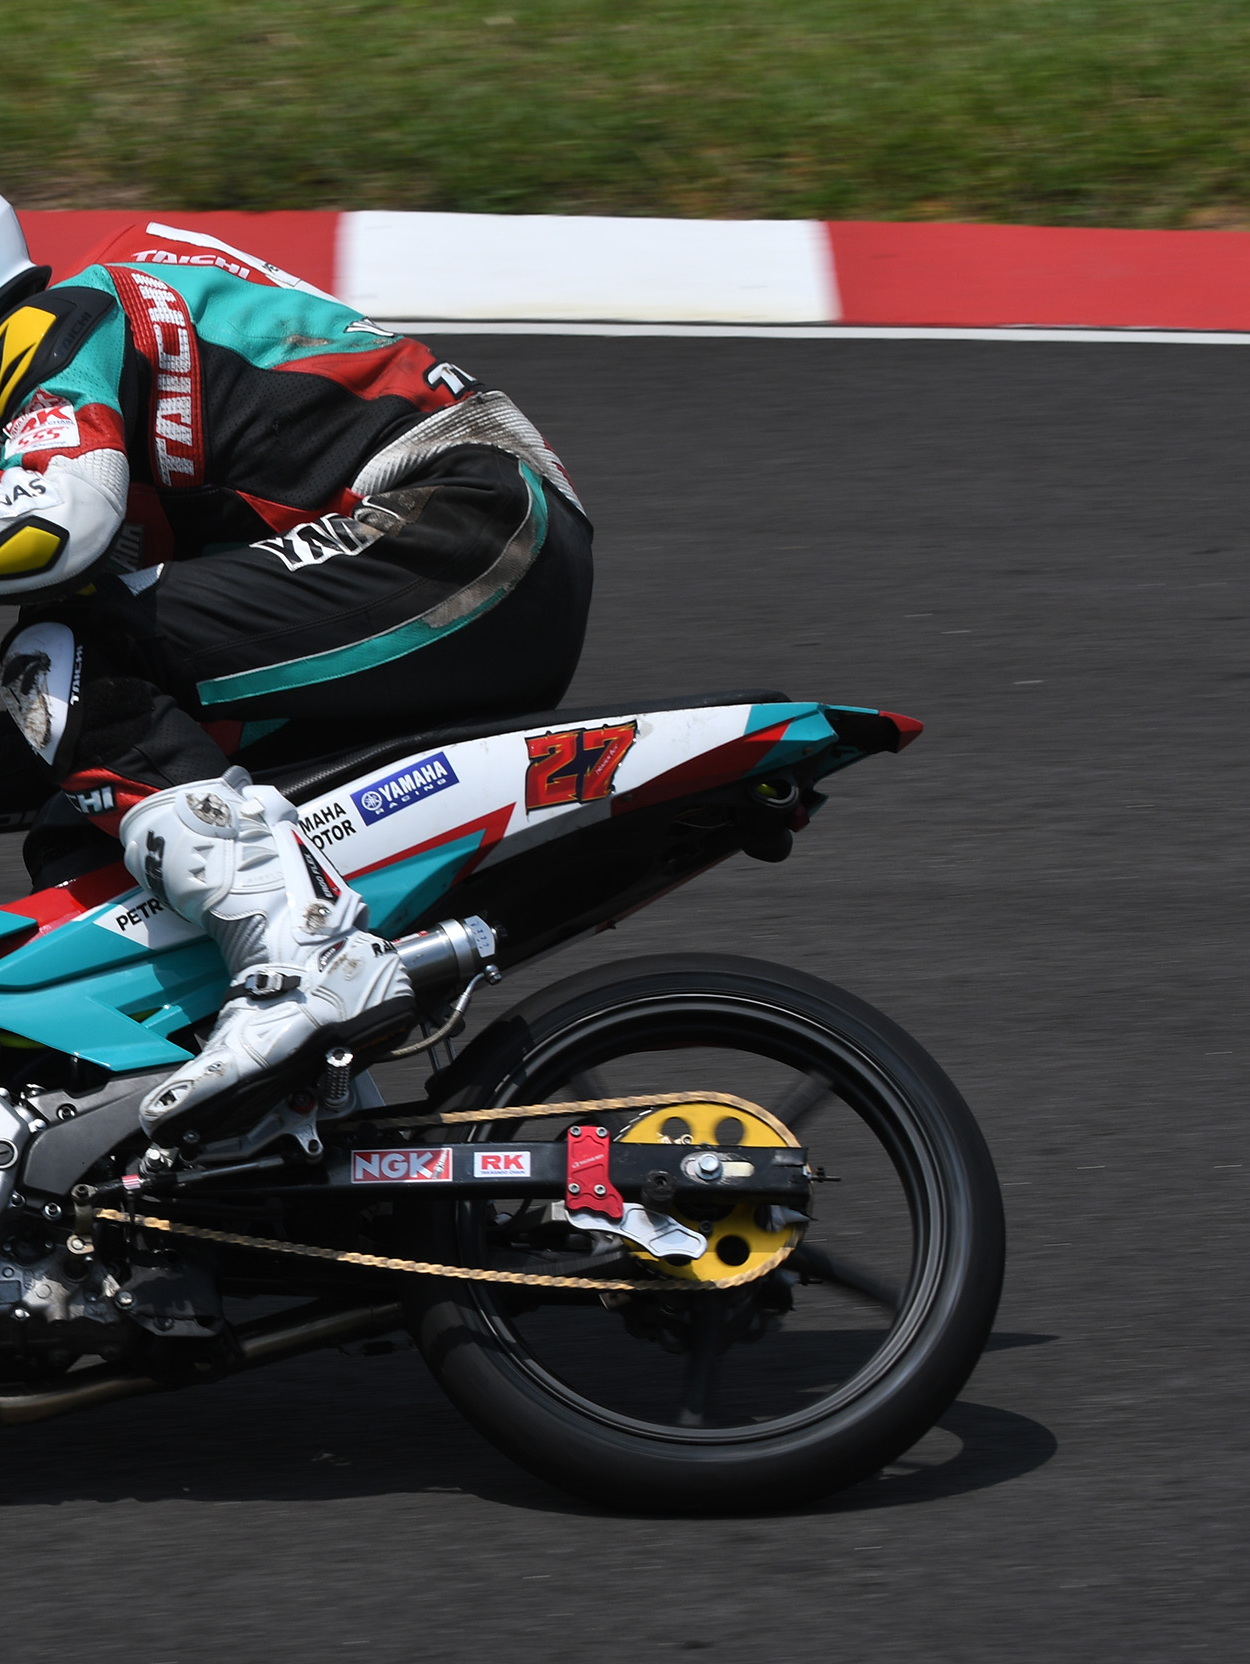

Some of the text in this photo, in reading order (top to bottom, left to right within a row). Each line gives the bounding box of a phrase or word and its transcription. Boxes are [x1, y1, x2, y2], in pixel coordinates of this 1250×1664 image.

[130, 249, 250, 280] TAICHI
[131, 273, 195, 487] TAICHI
[378, 760, 448, 802] YAMAHA
[524, 719, 638, 814] 27
[375, 778, 447, 815] RACING
[300, 802, 347, 834] MAHA
[311, 819, 357, 851] OTOR
[115, 898, 164, 932] PETR
[354, 1152, 434, 1180] NGK
[481, 1154, 525, 1170] RK
